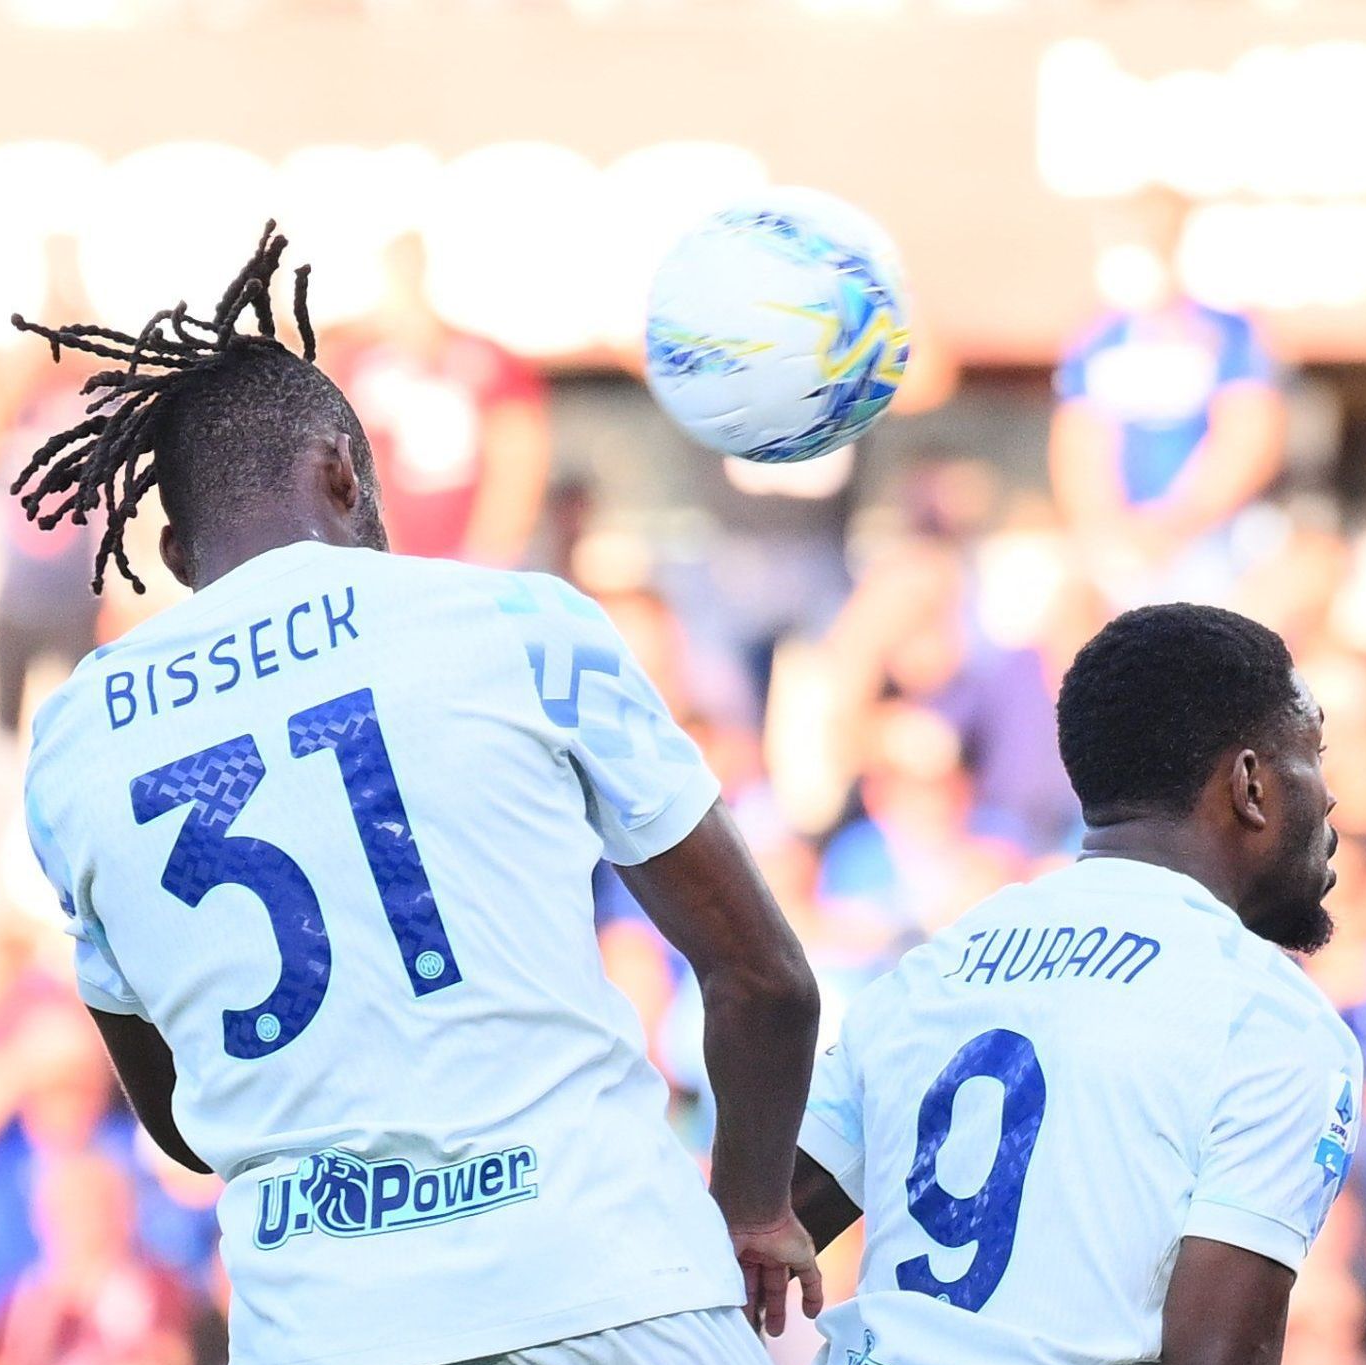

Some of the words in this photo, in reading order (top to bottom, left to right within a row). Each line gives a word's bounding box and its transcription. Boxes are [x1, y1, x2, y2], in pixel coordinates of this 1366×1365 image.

[104, 586, 360, 731] BISSECK
[129, 687, 463, 1060] 31
[895, 1028, 1047, 1314] 9
